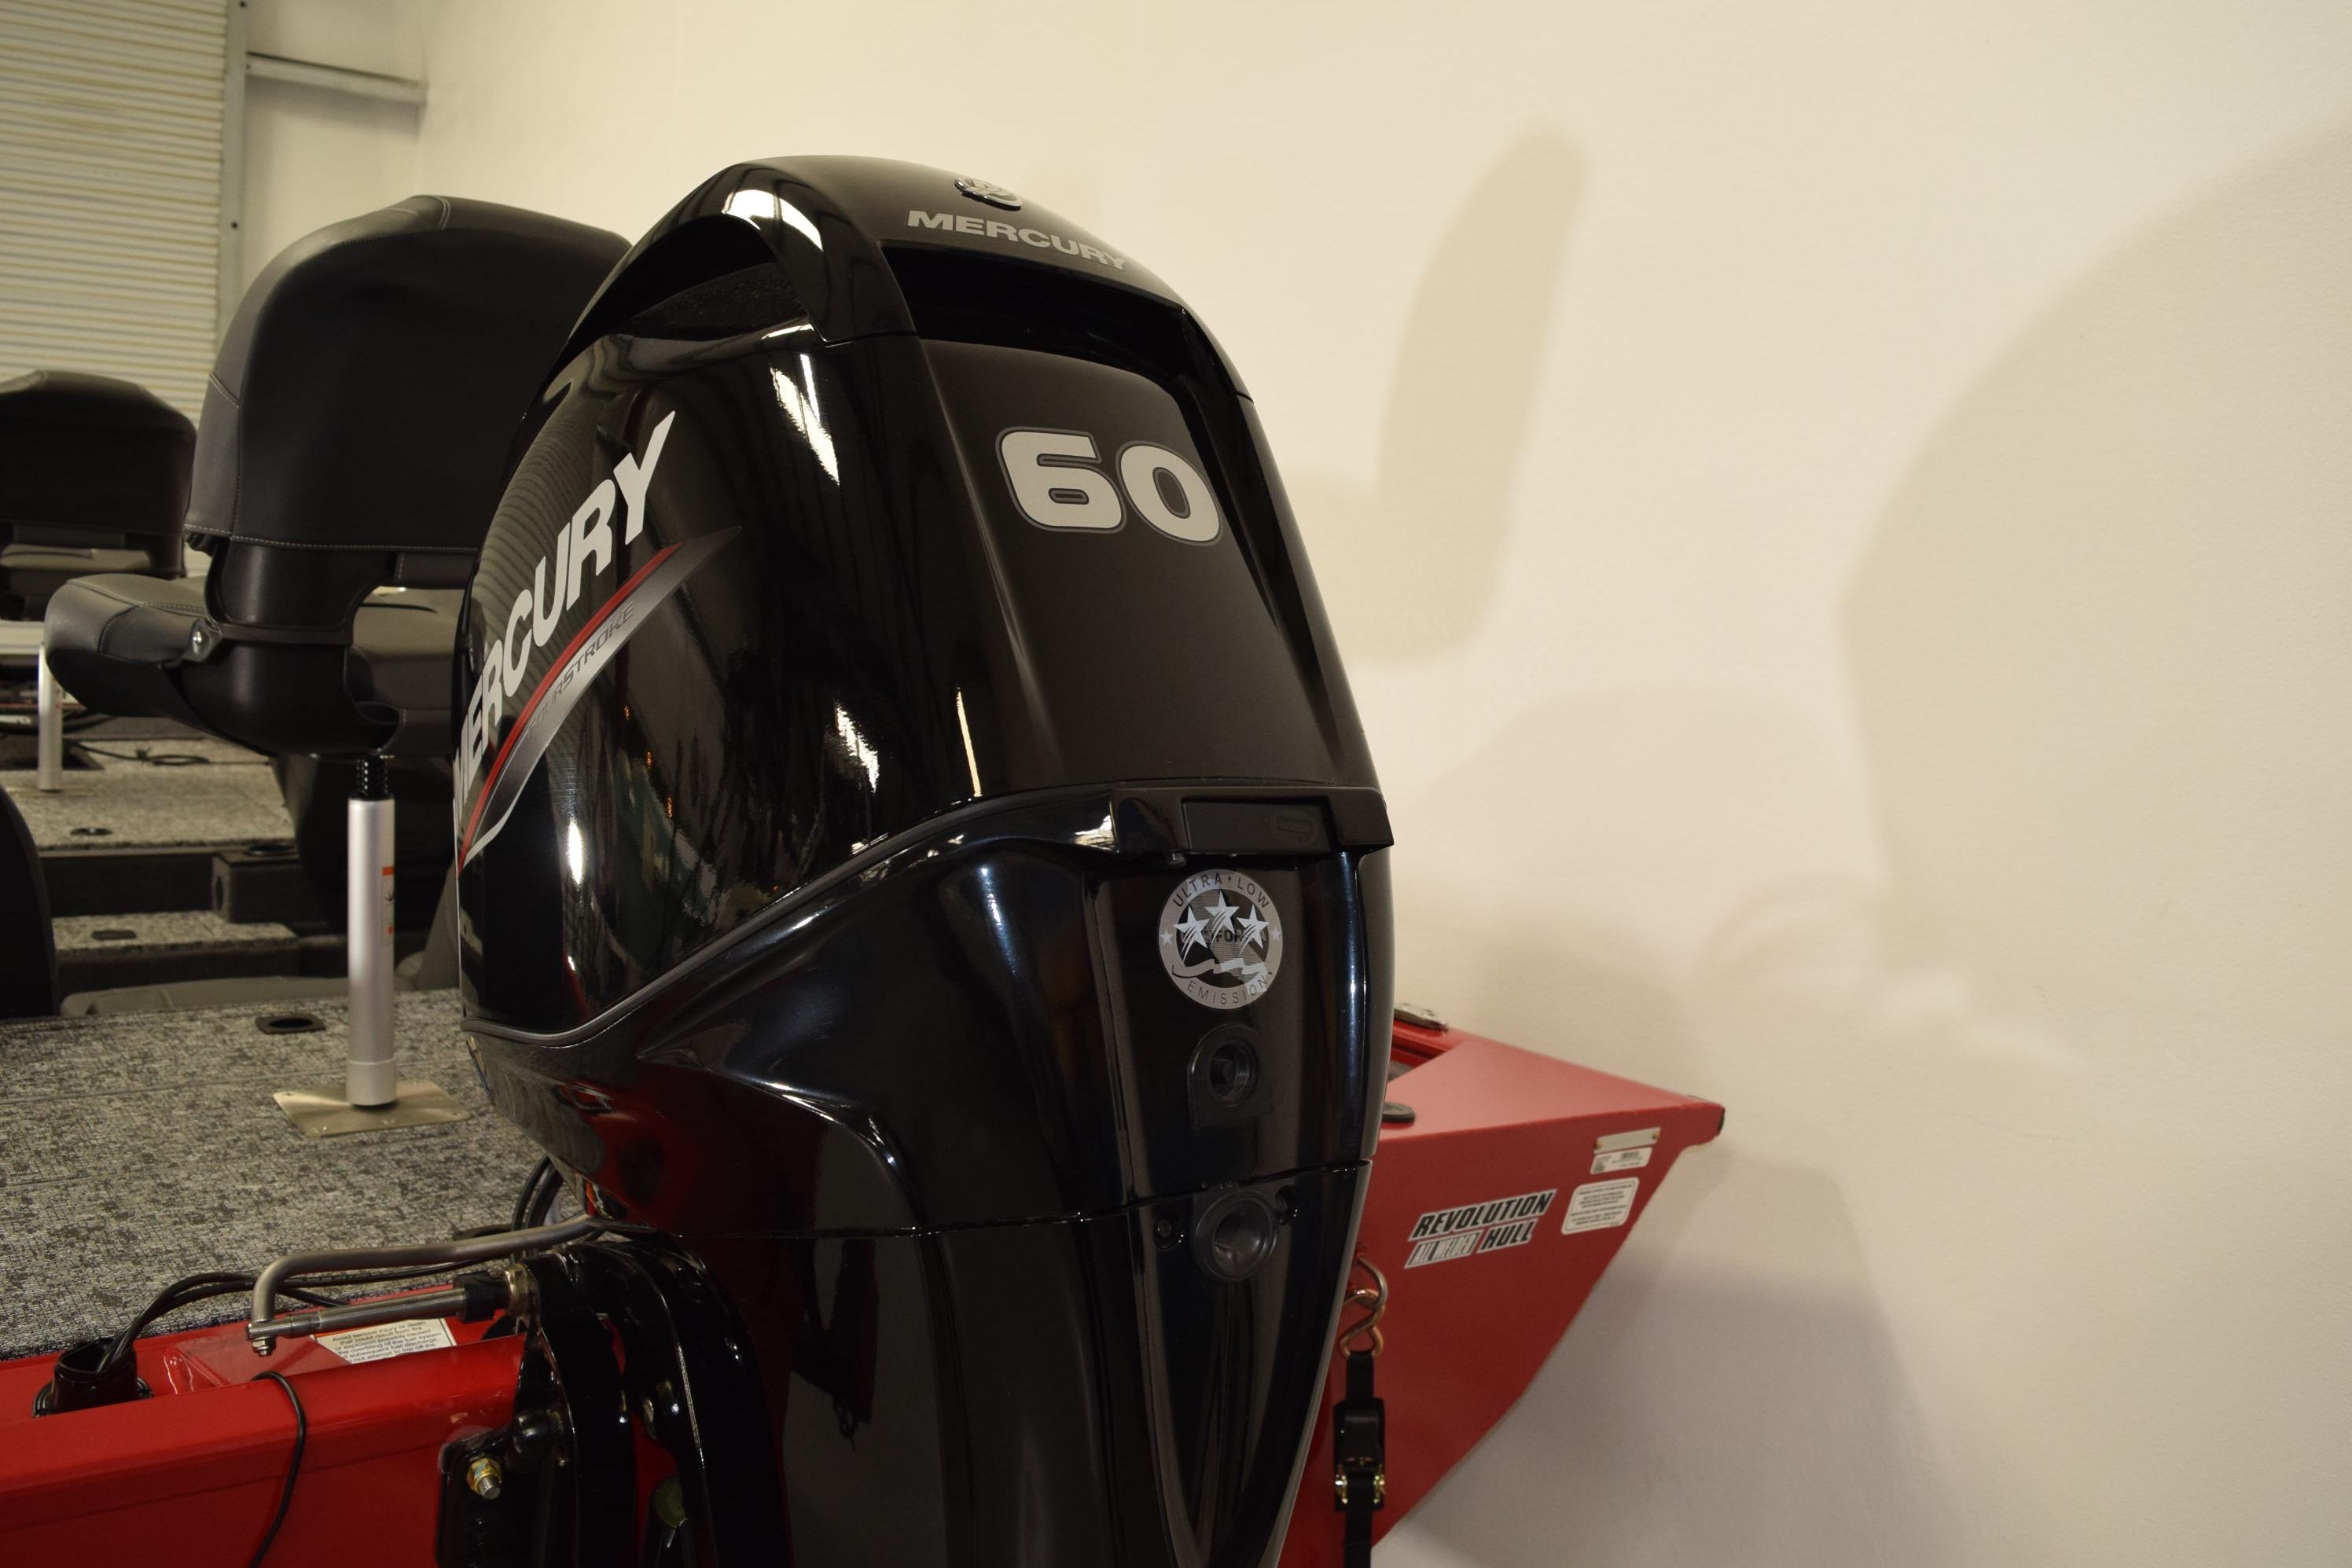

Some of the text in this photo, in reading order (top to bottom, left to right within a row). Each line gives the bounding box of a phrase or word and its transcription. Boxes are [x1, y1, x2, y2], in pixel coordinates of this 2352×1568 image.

[907, 210, 1126, 270] MERCURY
[995, 425, 1224, 546] 60
[454, 410, 676, 825] MERCURY
[1187, 976, 1267, 1004] EMISSION
[1412, 1192, 1554, 1239] REVOLUTION
[1479, 1221, 1535, 1250] HULL
